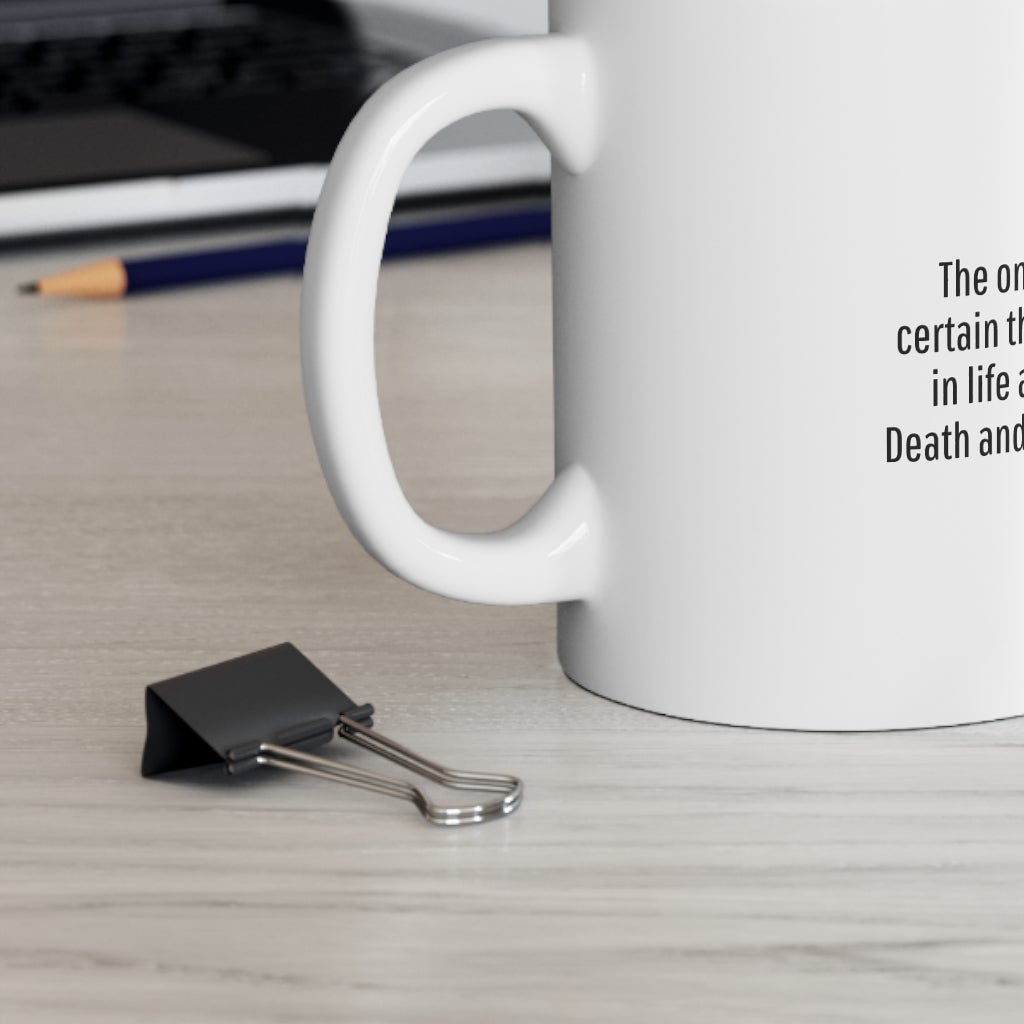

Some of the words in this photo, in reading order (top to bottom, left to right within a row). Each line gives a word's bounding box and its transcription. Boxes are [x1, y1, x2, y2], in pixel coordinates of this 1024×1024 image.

[938, 258, 988, 298] The
[897, 311, 999, 355] certain
[932, 368, 958, 407] in
[968, 362, 1010, 404] life
[886, 420, 970, 463] Death
